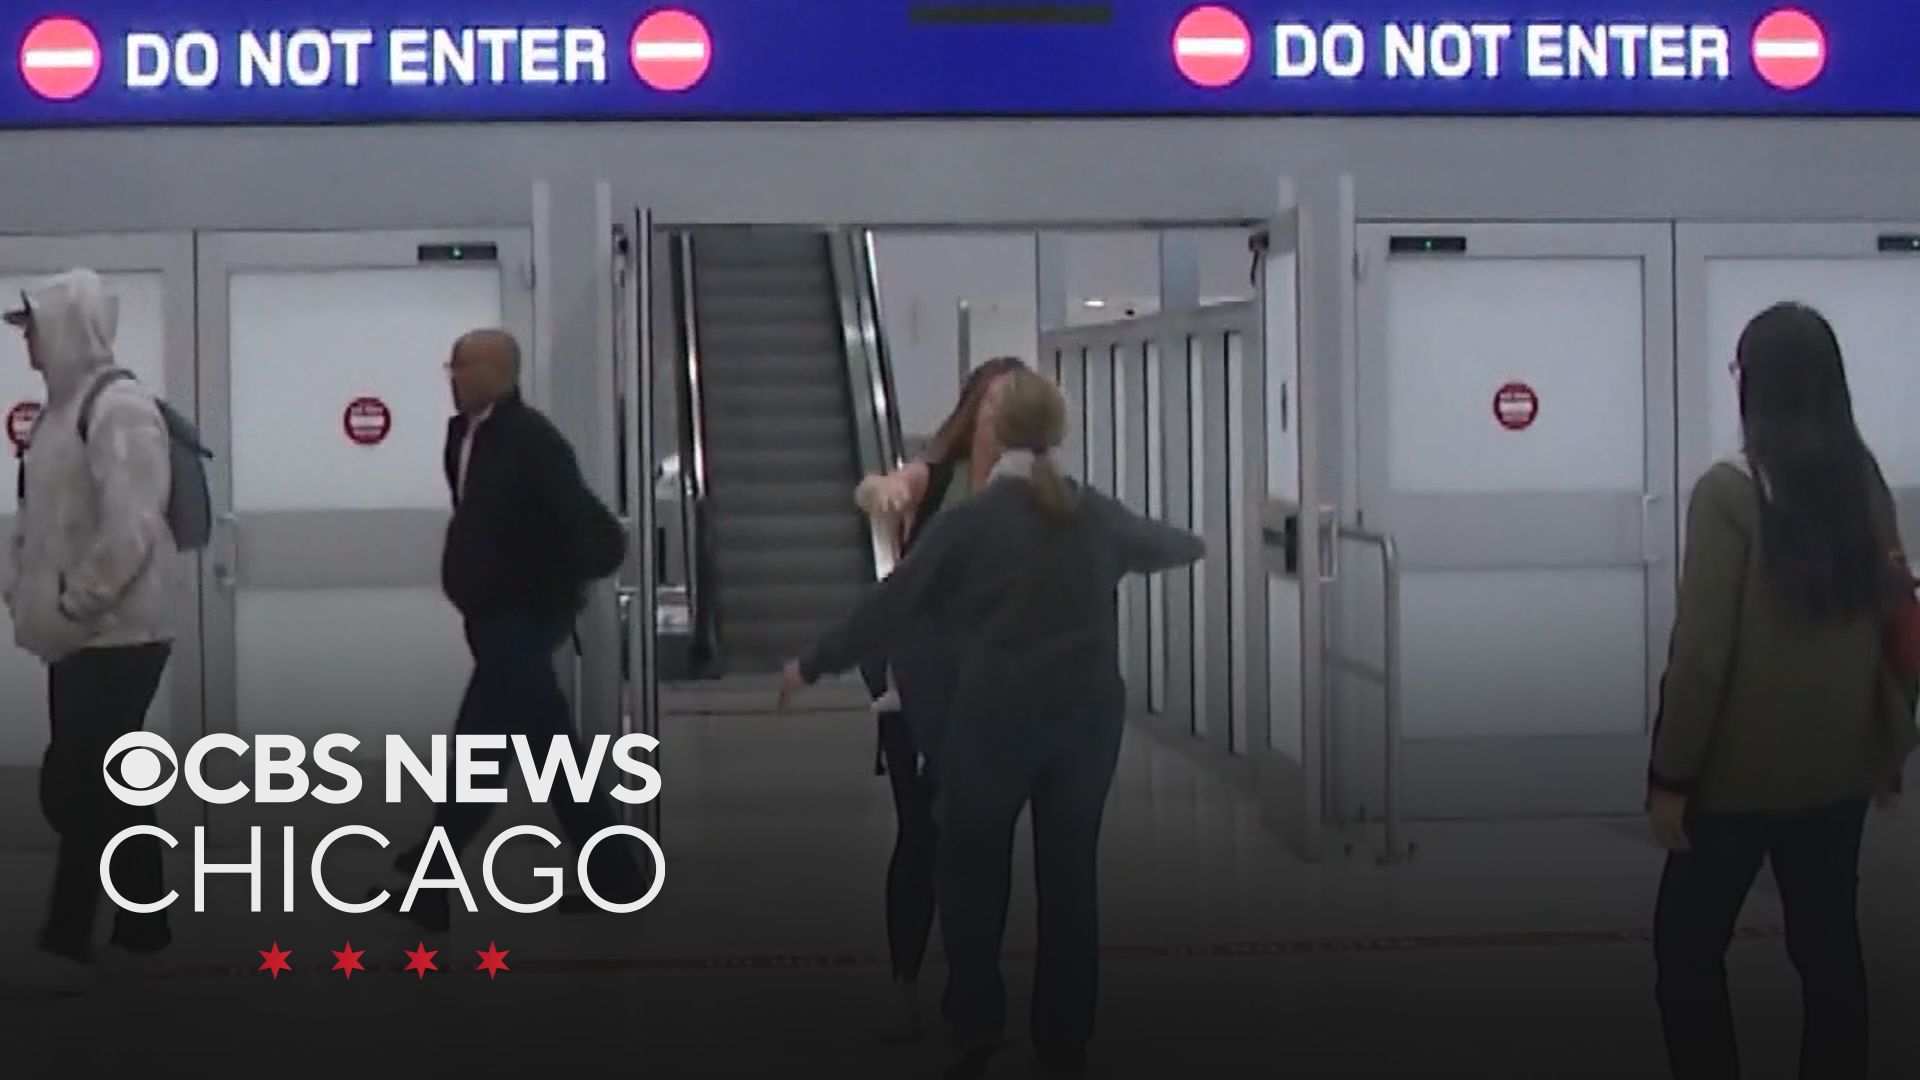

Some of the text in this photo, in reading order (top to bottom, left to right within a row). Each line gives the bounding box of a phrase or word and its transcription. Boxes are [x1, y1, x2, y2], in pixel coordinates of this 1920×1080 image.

[126, 28, 606, 87] DO NOT ENTER
[1275, 24, 1729, 79] DO NOT ENTER
